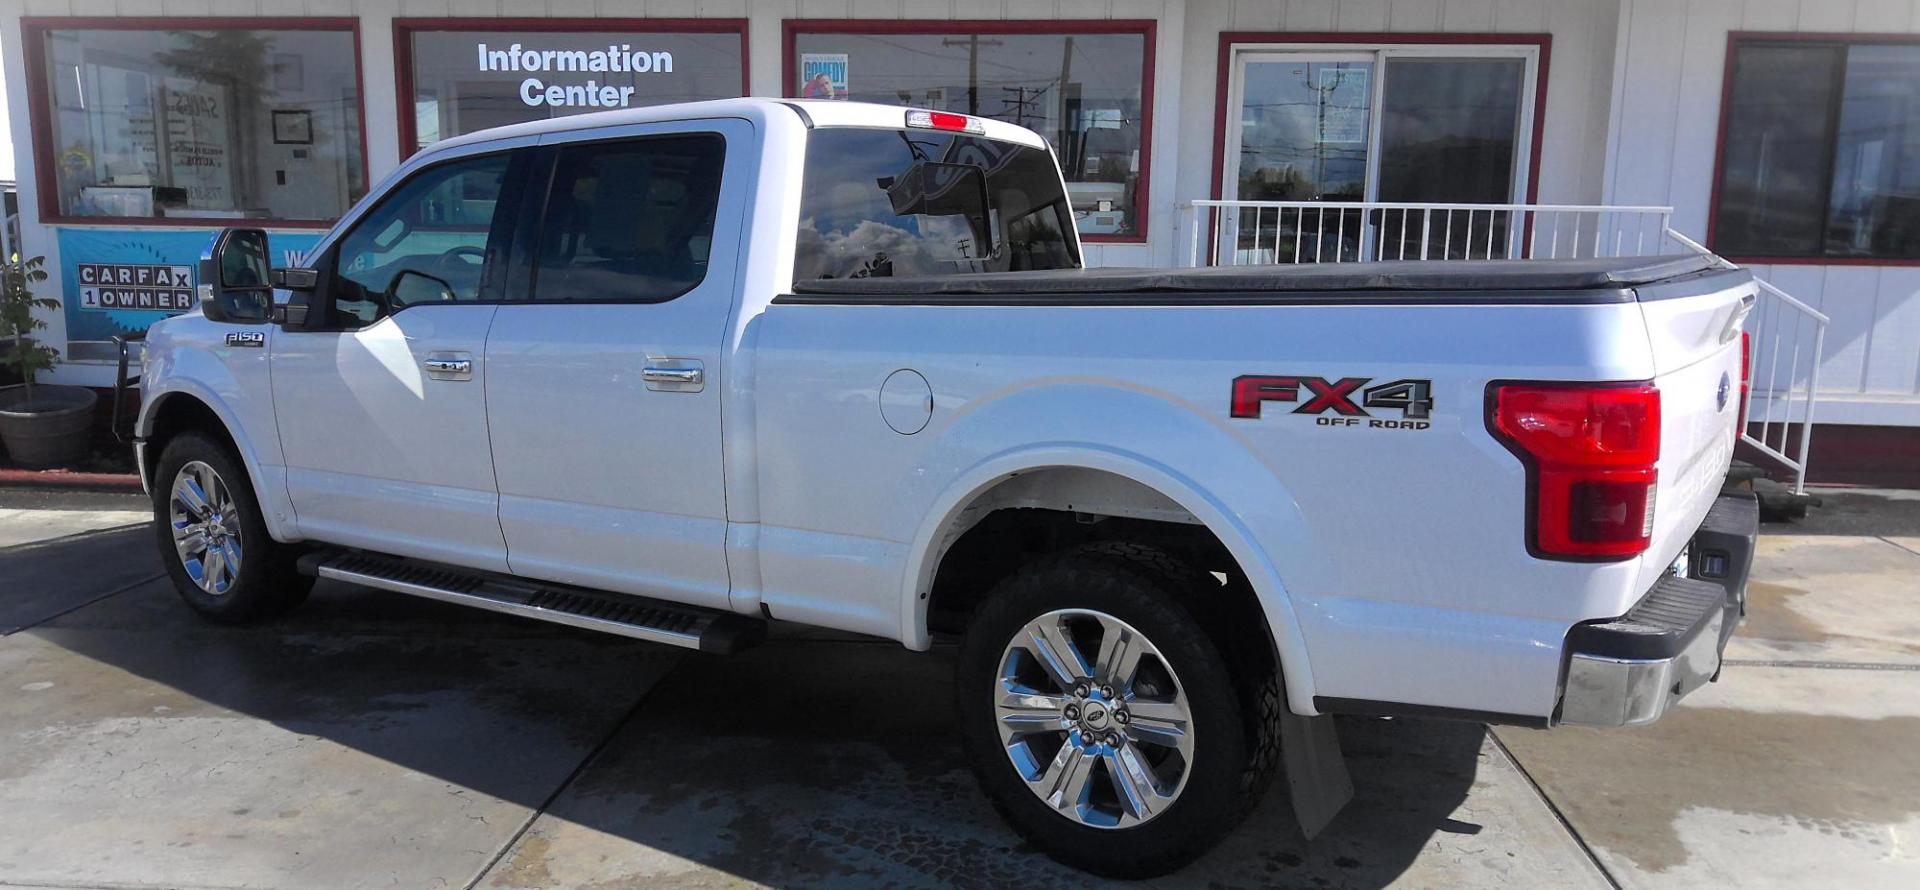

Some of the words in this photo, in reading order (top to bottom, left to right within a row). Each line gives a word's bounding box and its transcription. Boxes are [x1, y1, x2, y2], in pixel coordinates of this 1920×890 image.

[478, 43, 673, 73] Information
[520, 78, 635, 107] Center
[81, 266, 189, 288] CARFAX
[84, 290, 96, 305] 1
[102, 291, 190, 307] OWNER
[1230, 374, 1433, 419] FX4
[1315, 417, 1361, 427] OFF
[1369, 419, 1432, 430] ROAD
